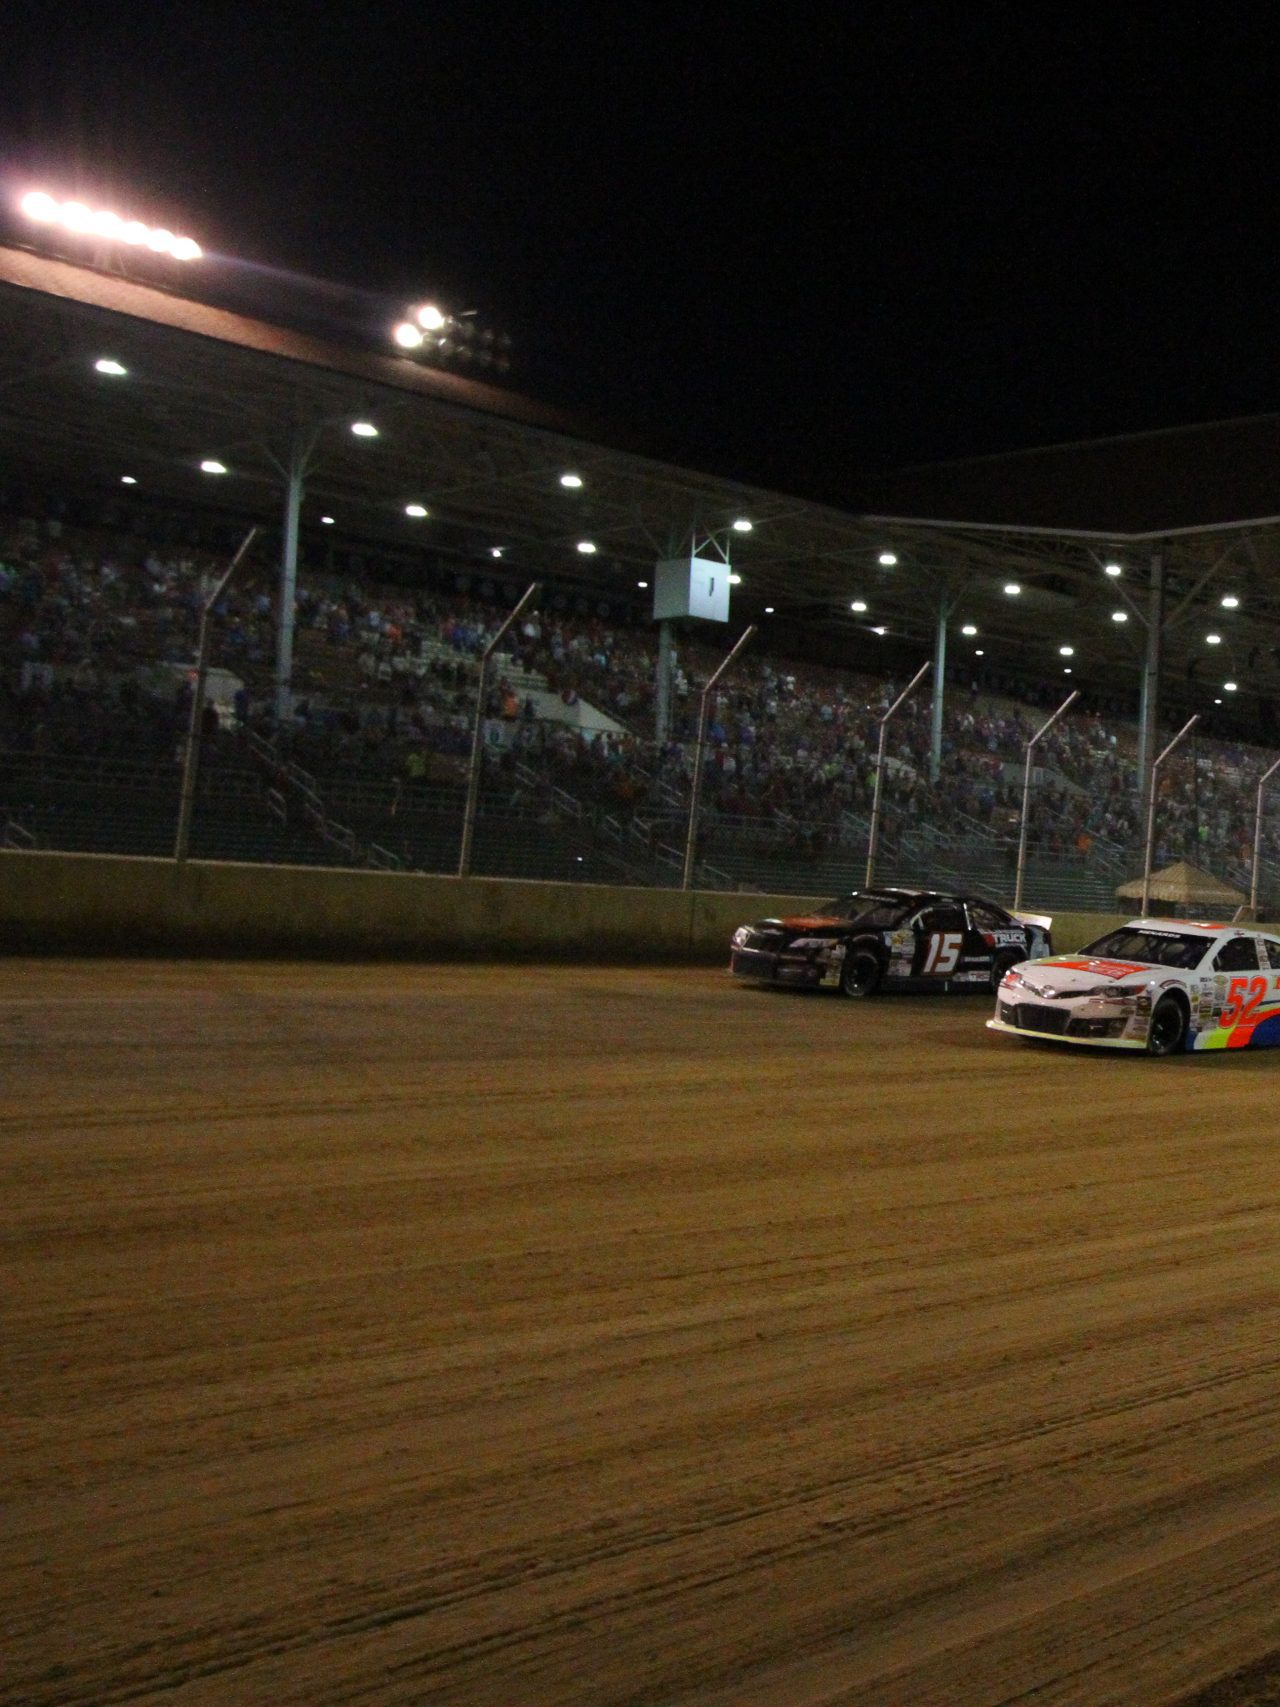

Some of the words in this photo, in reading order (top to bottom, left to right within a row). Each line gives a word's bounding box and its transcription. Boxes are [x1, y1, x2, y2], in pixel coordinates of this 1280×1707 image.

[923, 933, 962, 972] 15
[993, 932, 1026, 944] TRUCK
[1219, 975, 1268, 1028] 52
